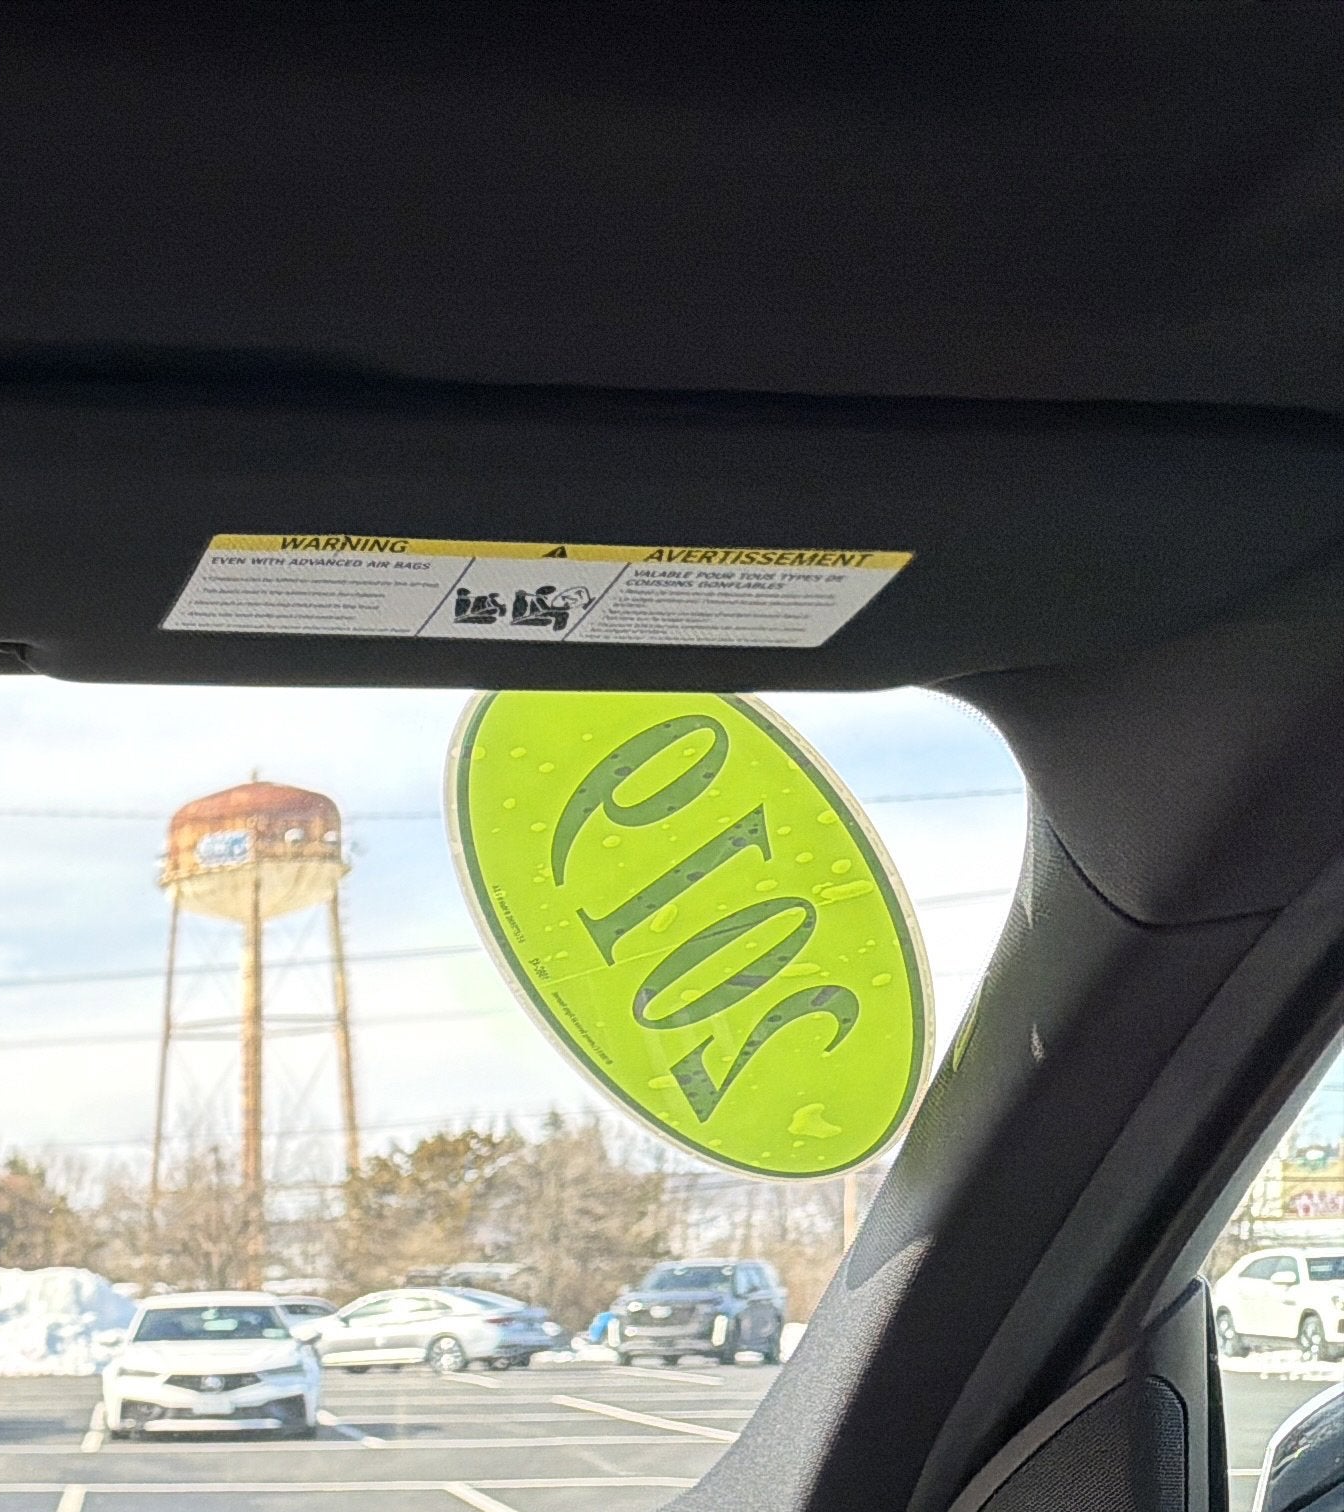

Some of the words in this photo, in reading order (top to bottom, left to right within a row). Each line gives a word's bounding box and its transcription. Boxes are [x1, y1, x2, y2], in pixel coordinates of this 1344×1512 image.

[280, 536, 410, 554] WARNING
[211, 556, 247, 566] EVEN
[251, 557, 284, 567] WITH
[289, 558, 363, 569] ADVANCED
[367, 560, 389, 569] AIR
[393, 562, 432, 571] BAGS
[642, 548, 876, 568] AVERTISSEMENT
[633, 569, 693, 579] VALABLE
[696, 570, 735, 581] POUR
[738, 572, 775, 582] TOUS
[780, 573, 821, 583] TYPES
[625, 578, 694, 588] COUSSINS
[697, 580, 786, 590] GONFLABLES
